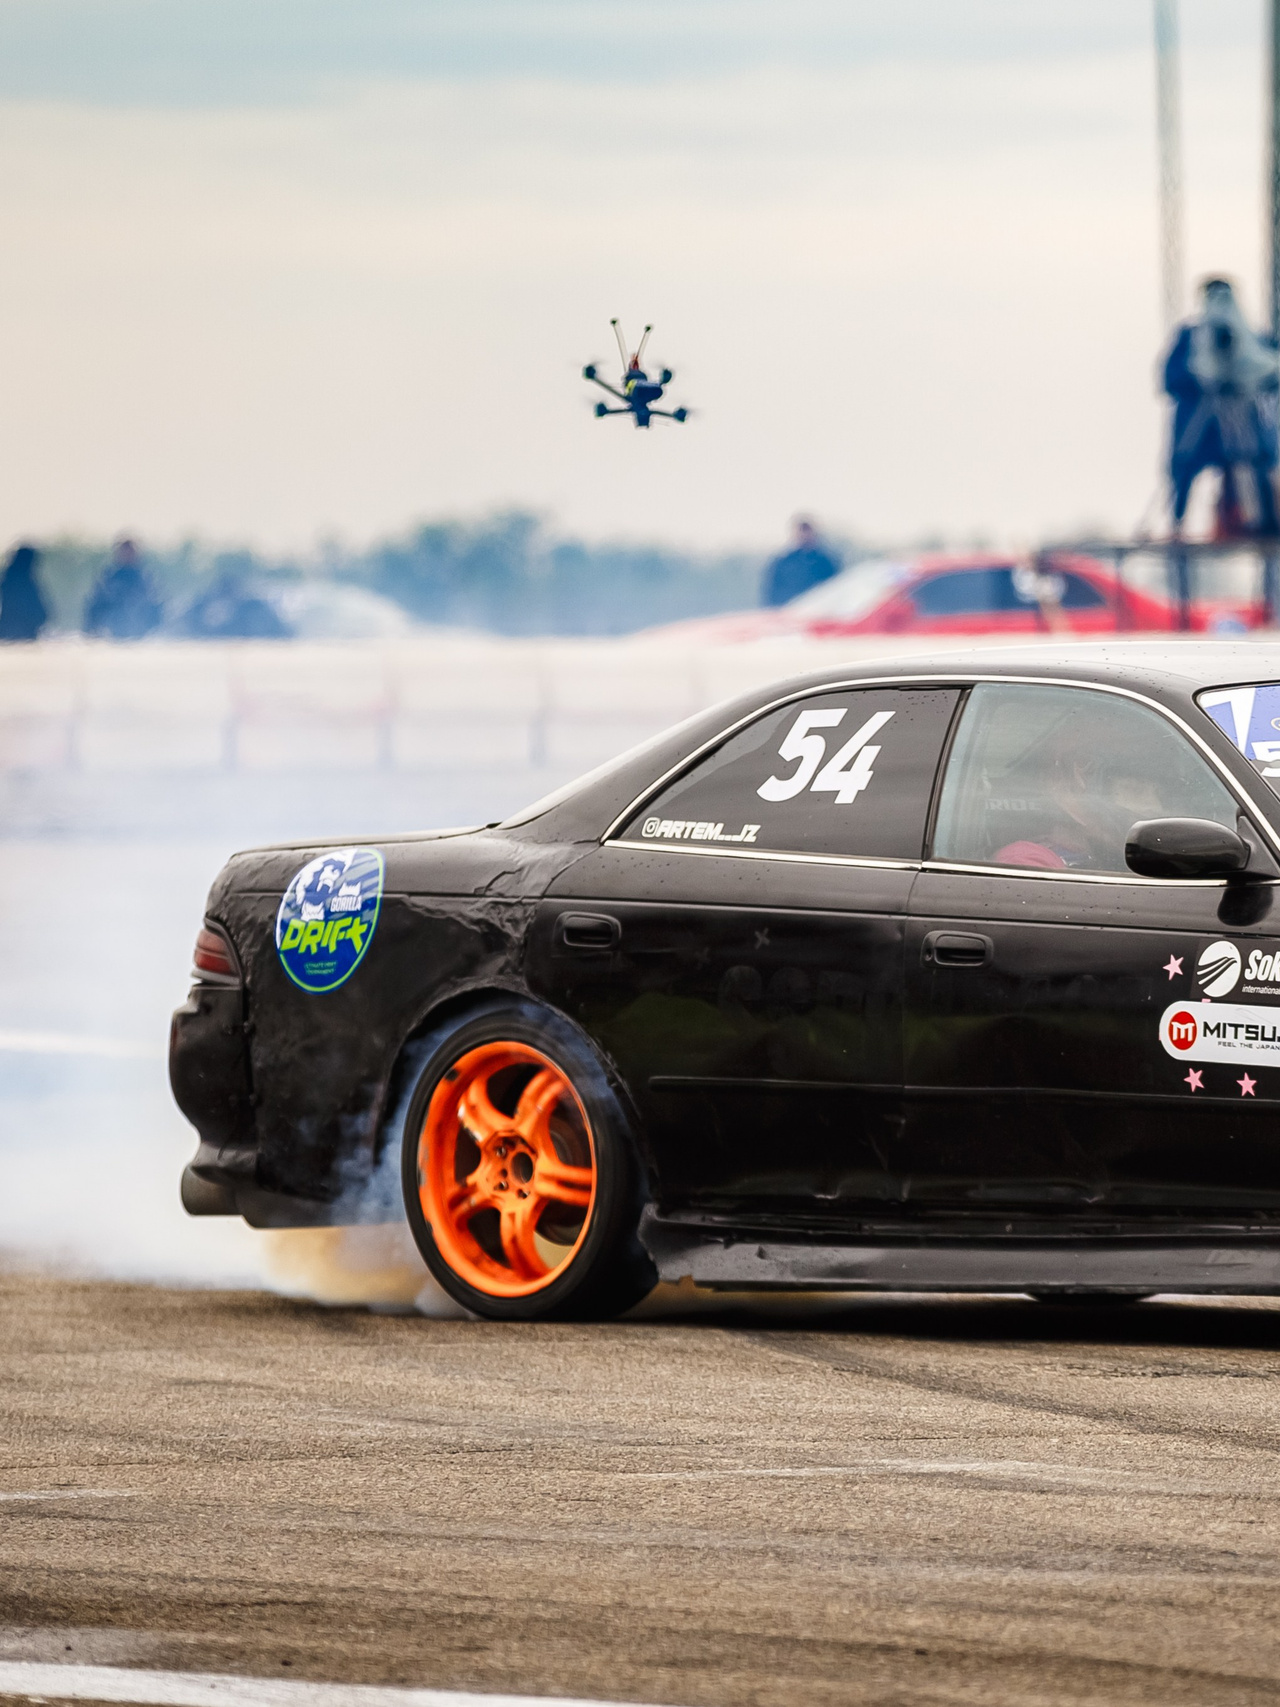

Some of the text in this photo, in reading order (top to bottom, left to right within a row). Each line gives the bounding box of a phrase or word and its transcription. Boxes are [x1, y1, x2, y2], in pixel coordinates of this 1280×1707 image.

[756, 707, 896, 804] 54
[330, 896, 363, 912] GORILLA
[280, 916, 368, 955] DRIFT
[1217, 1040, 1237, 1048] FEEL
[1255, 1043, 1280, 1051] JAPAN
